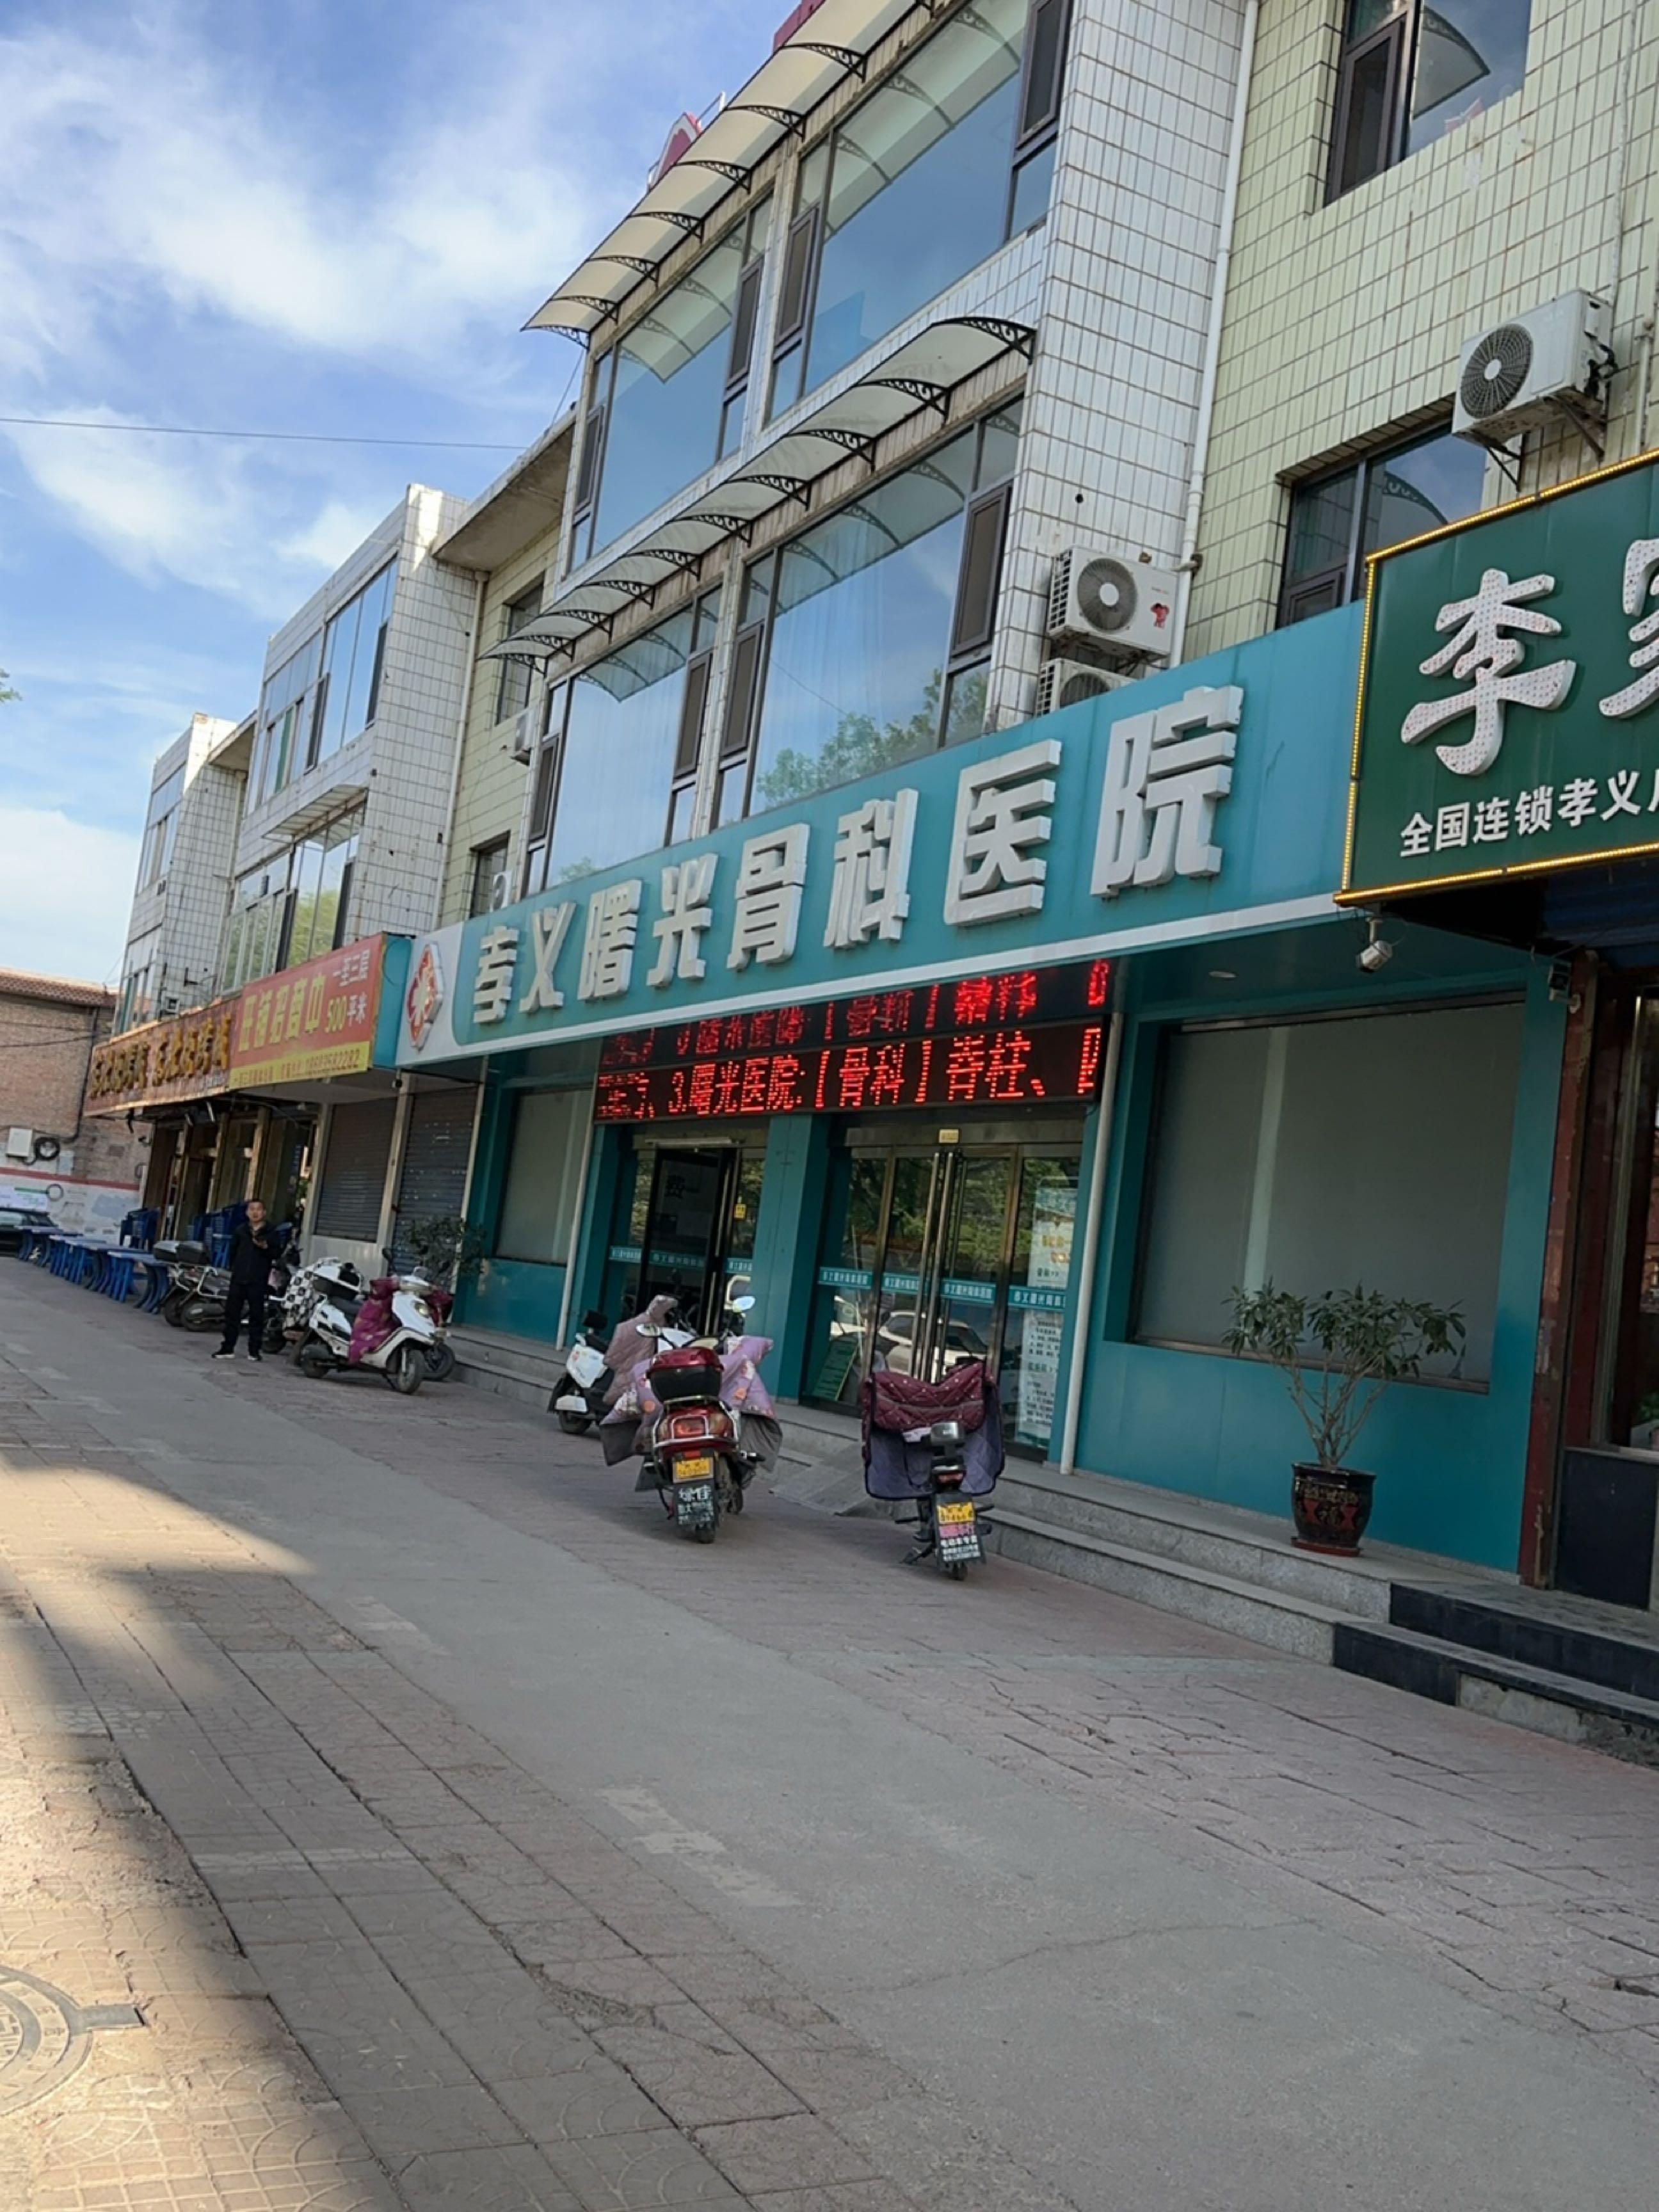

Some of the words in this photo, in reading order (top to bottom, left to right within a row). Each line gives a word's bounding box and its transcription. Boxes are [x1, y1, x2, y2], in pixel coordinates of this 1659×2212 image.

[472, 683, 1245, 1025] 孝义曙光骨科医院
[1400, 769, 1659, 857] 全国连锁孝义
